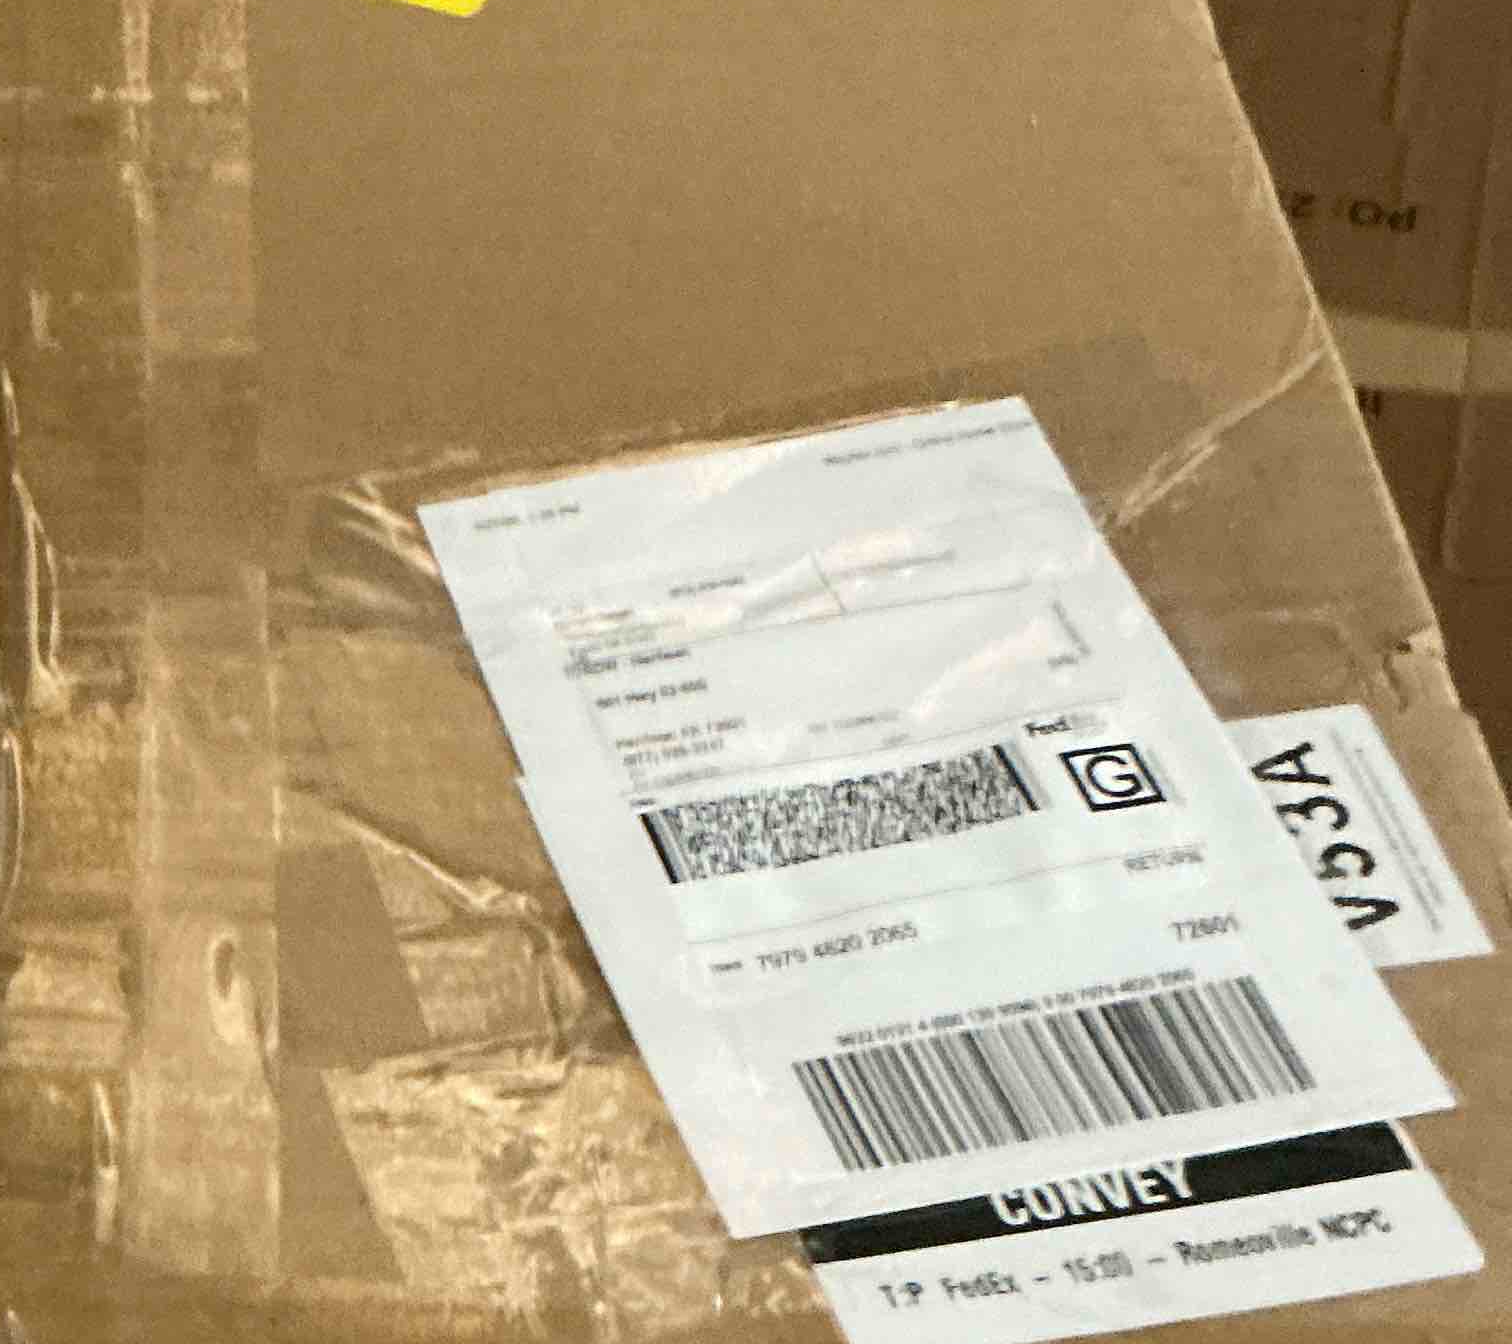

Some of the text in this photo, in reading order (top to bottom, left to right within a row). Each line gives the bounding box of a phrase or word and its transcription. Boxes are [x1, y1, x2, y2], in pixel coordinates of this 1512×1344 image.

[1084, 755, 1145, 798] G
[990, 1156, 1196, 1227] CONVEY
[940, 1269, 1022, 1301] FedEx
